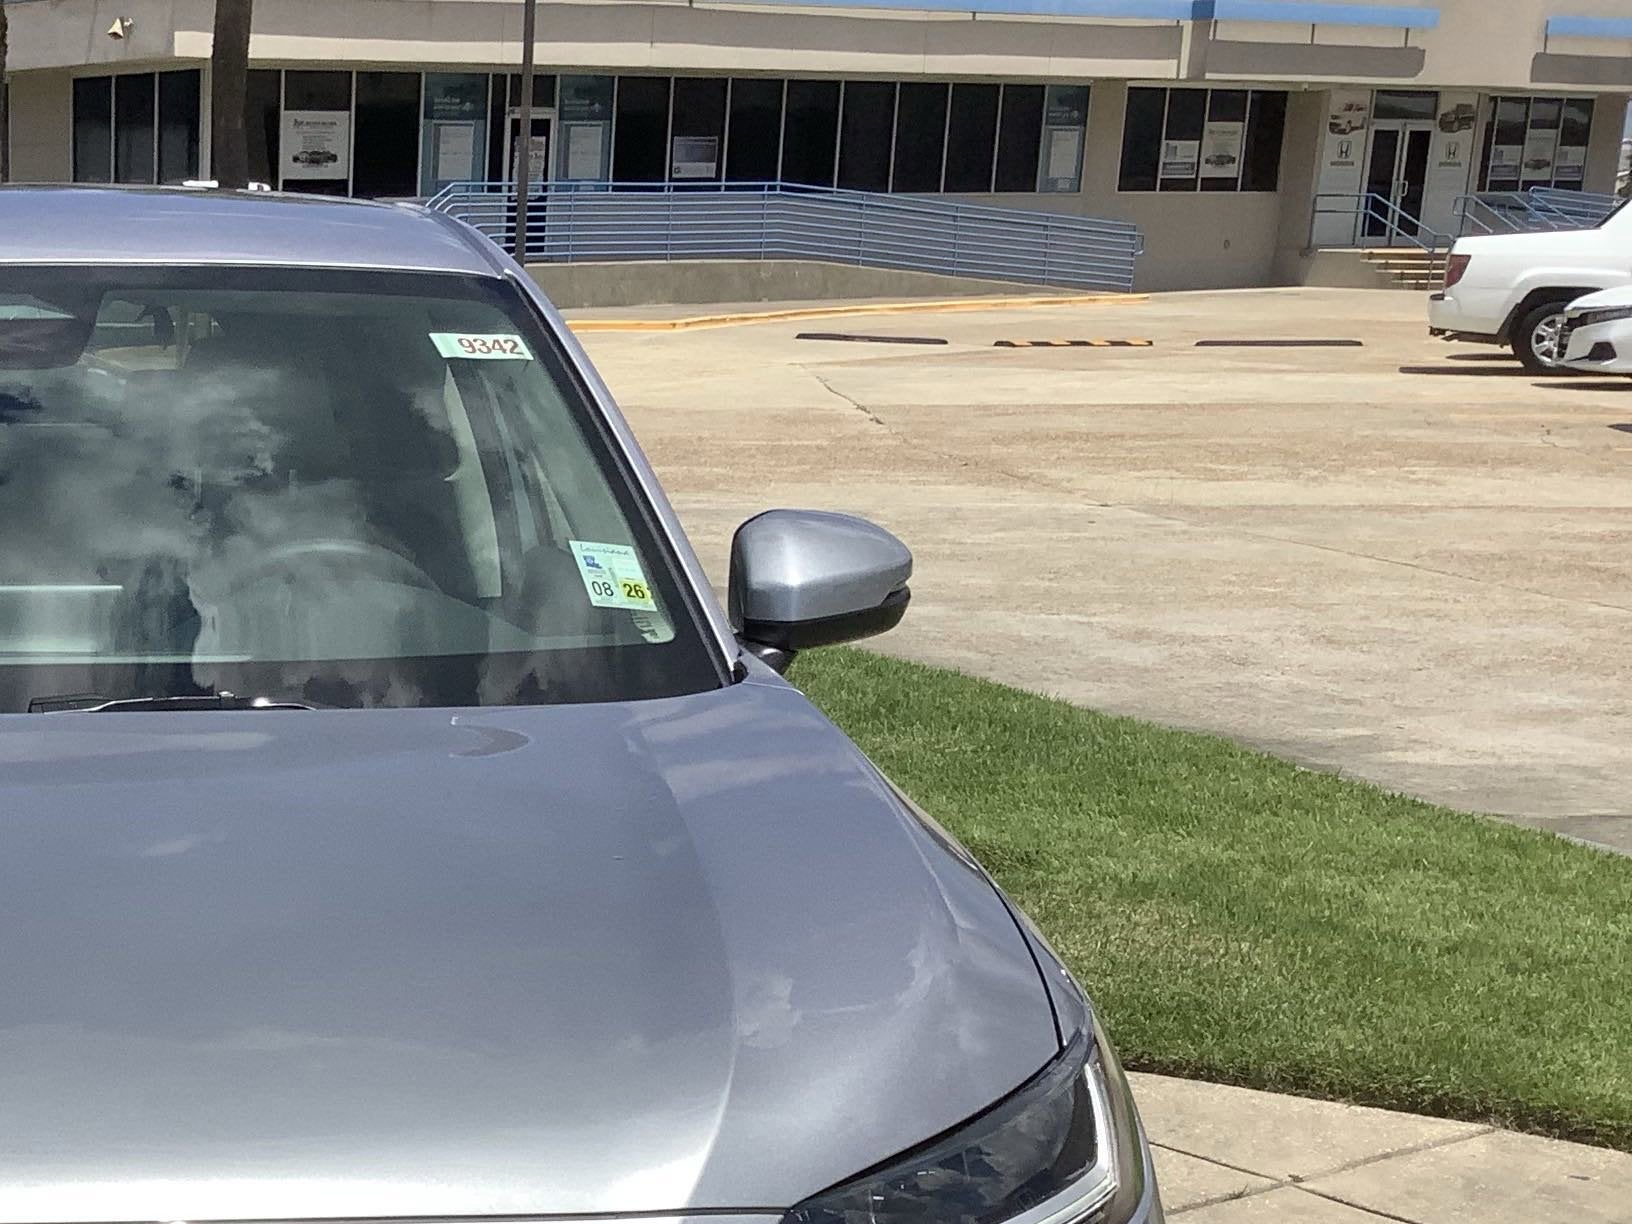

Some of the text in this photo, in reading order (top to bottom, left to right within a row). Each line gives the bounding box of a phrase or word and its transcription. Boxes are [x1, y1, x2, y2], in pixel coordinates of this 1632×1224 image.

[457, 338, 524, 355] 9342
[591, 581, 645, 599] 08 26
